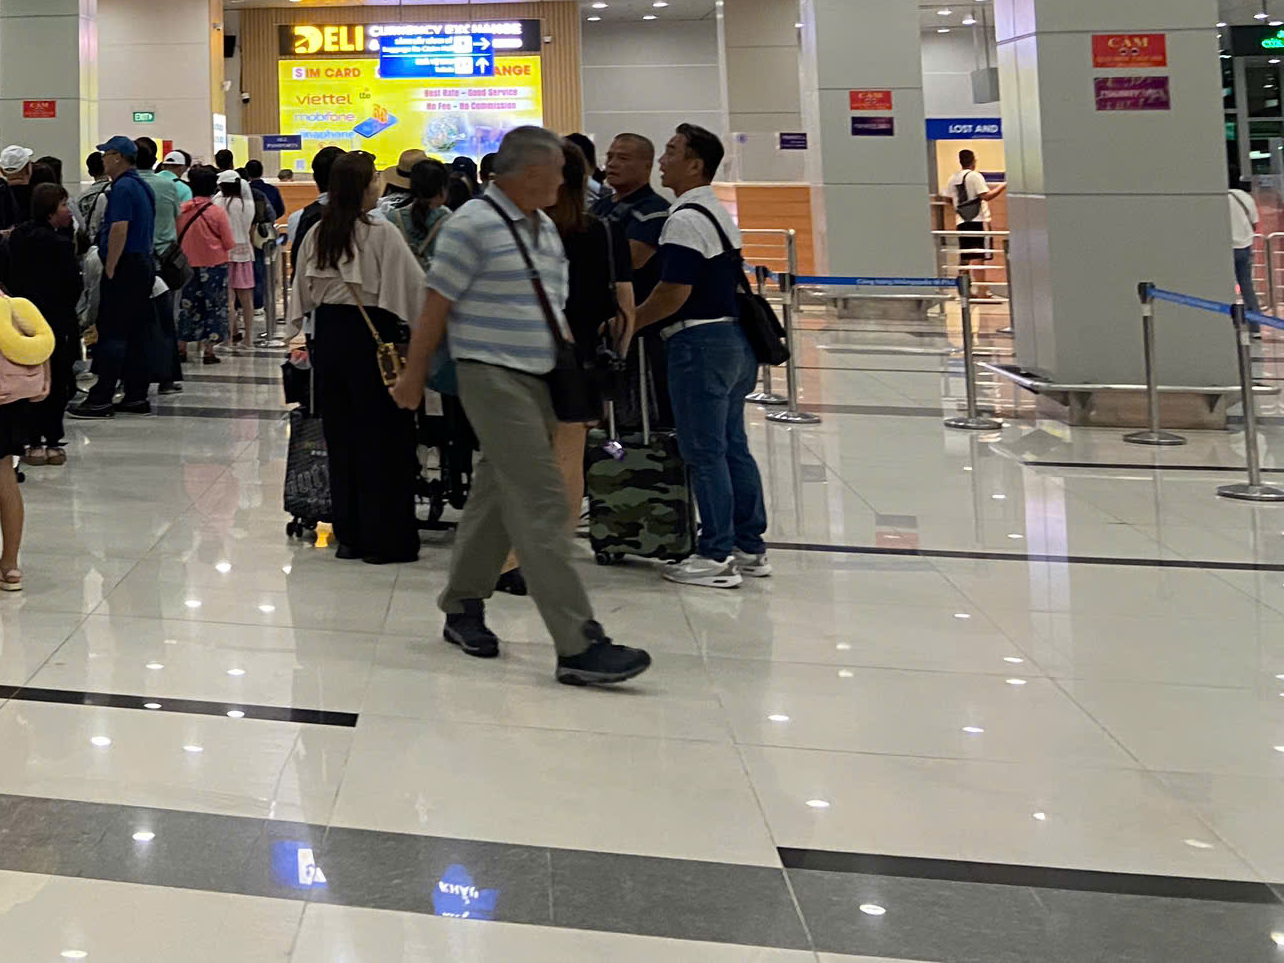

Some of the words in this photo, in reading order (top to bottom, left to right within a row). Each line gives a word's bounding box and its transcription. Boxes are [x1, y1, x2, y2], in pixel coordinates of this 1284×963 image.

[294, 25, 364, 54] DELI
[295, 67, 321, 78] SIM
[324, 67, 362, 78] CARD
[494, 65, 531, 76] ANGE
[488, 88, 518, 96] Service
[296, 93, 354, 106] viettel
[471, 101, 517, 110] Commission
[294, 111, 356, 122] mobifone
[948, 124, 973, 134] LOST
[974, 124, 999, 134] AND
